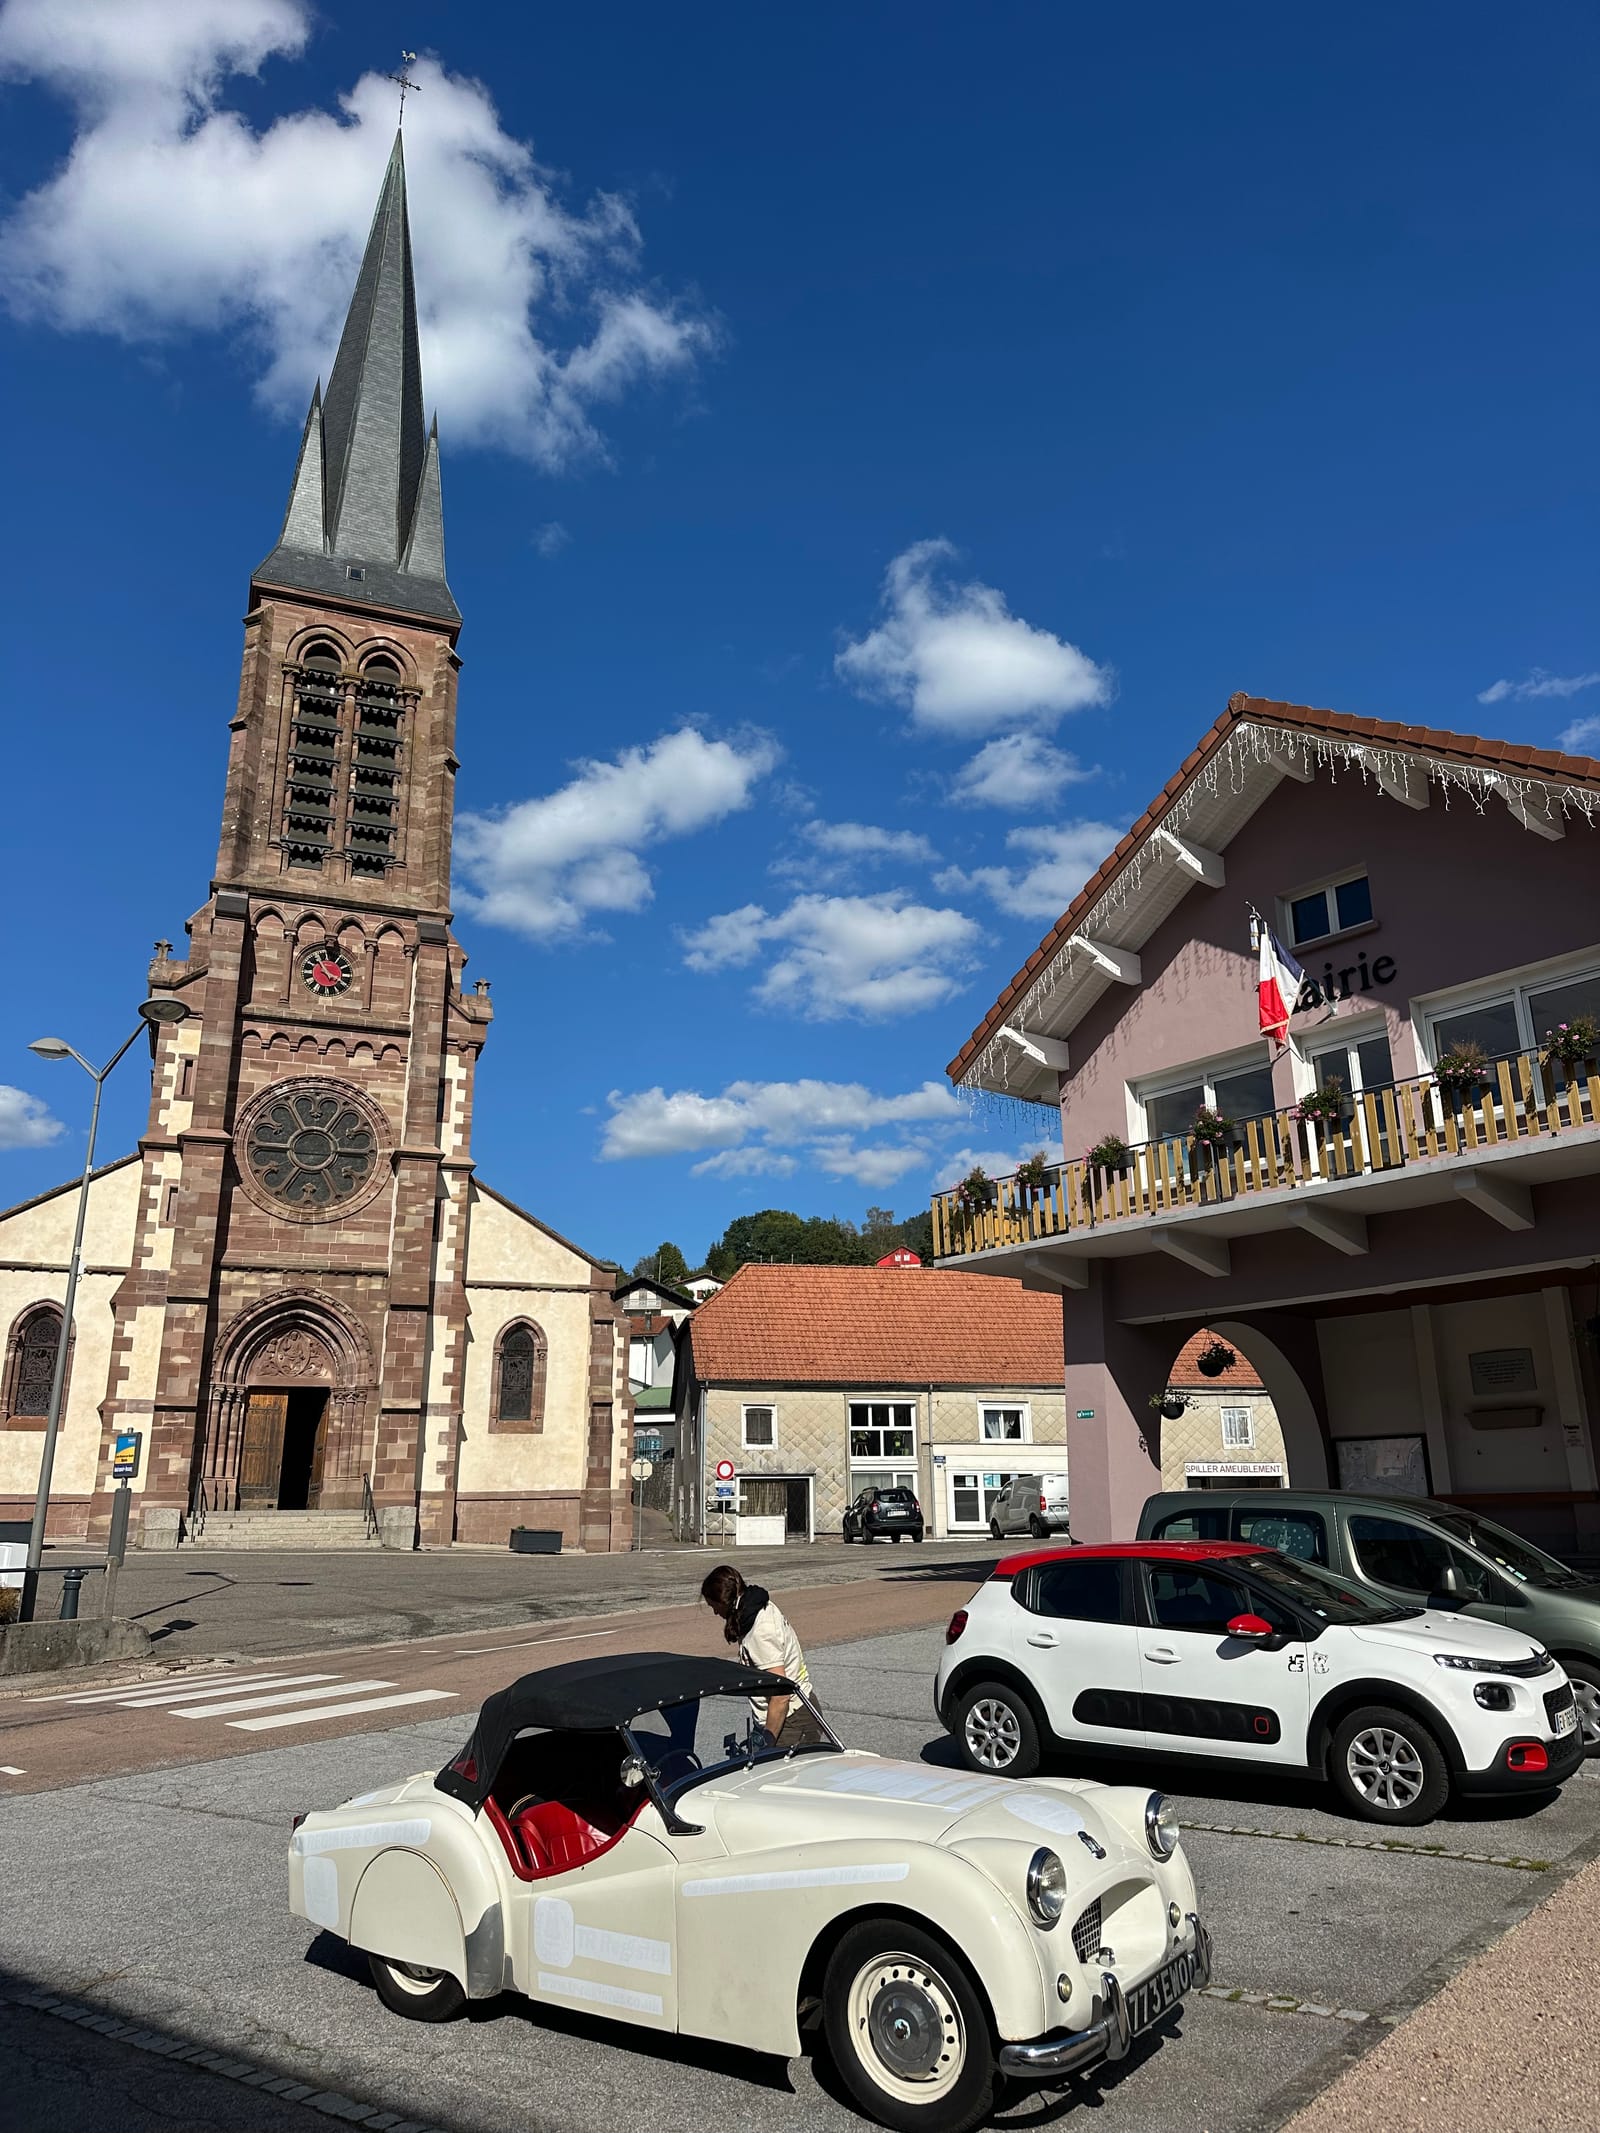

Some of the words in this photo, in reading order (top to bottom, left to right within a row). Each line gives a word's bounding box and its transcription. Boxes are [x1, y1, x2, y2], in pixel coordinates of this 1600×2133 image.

[1254, 951, 1398, 1015] airie
[1185, 1465, 1218, 1473] SPILLER
[1219, 1465, 1280, 1473] AMEUBLEMENT
